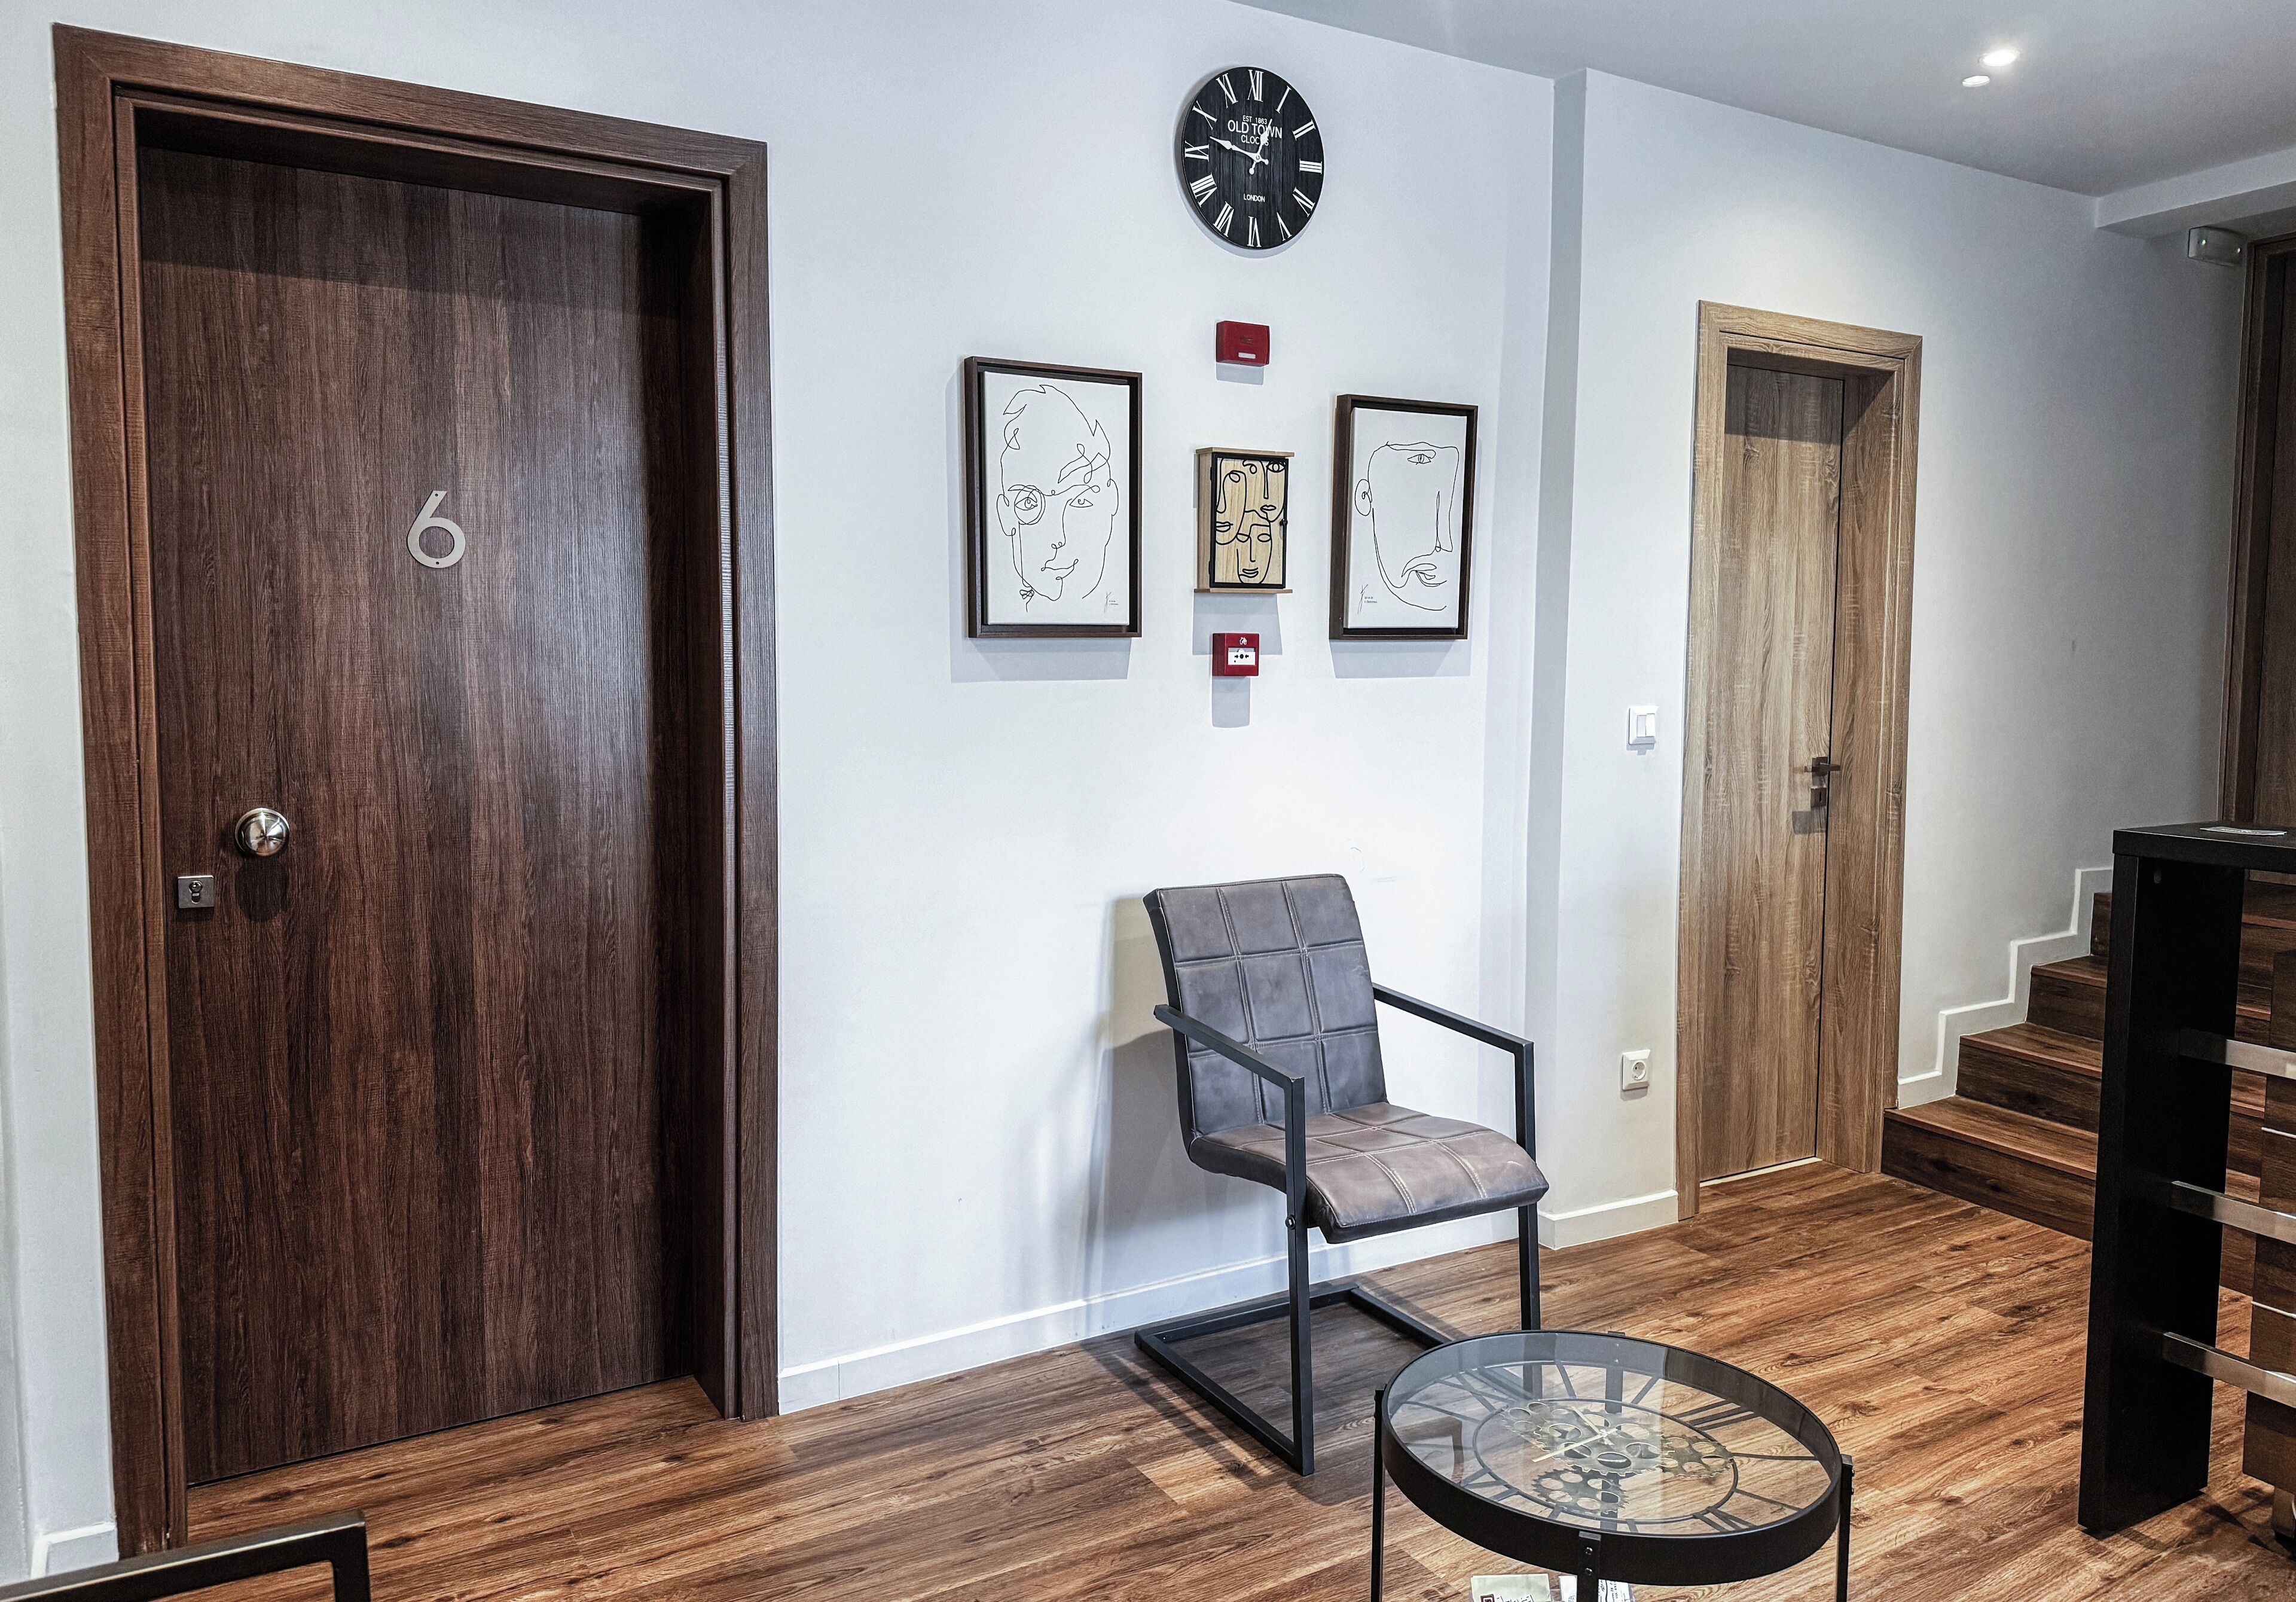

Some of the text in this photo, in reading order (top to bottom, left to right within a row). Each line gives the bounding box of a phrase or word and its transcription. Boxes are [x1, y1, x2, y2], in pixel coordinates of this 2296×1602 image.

[1216, 72, 1238, 108] XI
[1247, 69, 1264, 102] XII
[1275, 86, 1292, 114] I
[1192, 100, 1217, 130] X
[1228, 120, 1283, 139] OLD TOWN
[1241, 134, 1269, 146] CLOCS
[1292, 120, 1316, 141] II
[1184, 140, 1210, 162] IX
[1299, 158, 1323, 175] III
[1189, 172, 1218, 208] VIII
[1243, 193, 1265, 203] LONDON
[1292, 187, 1315, 217] IV
[1213, 201, 1235, 237] VII
[1247, 216, 1262, 248] VI
[1276, 212, 1293, 242] V
[407, 490, 466, 569] 6
